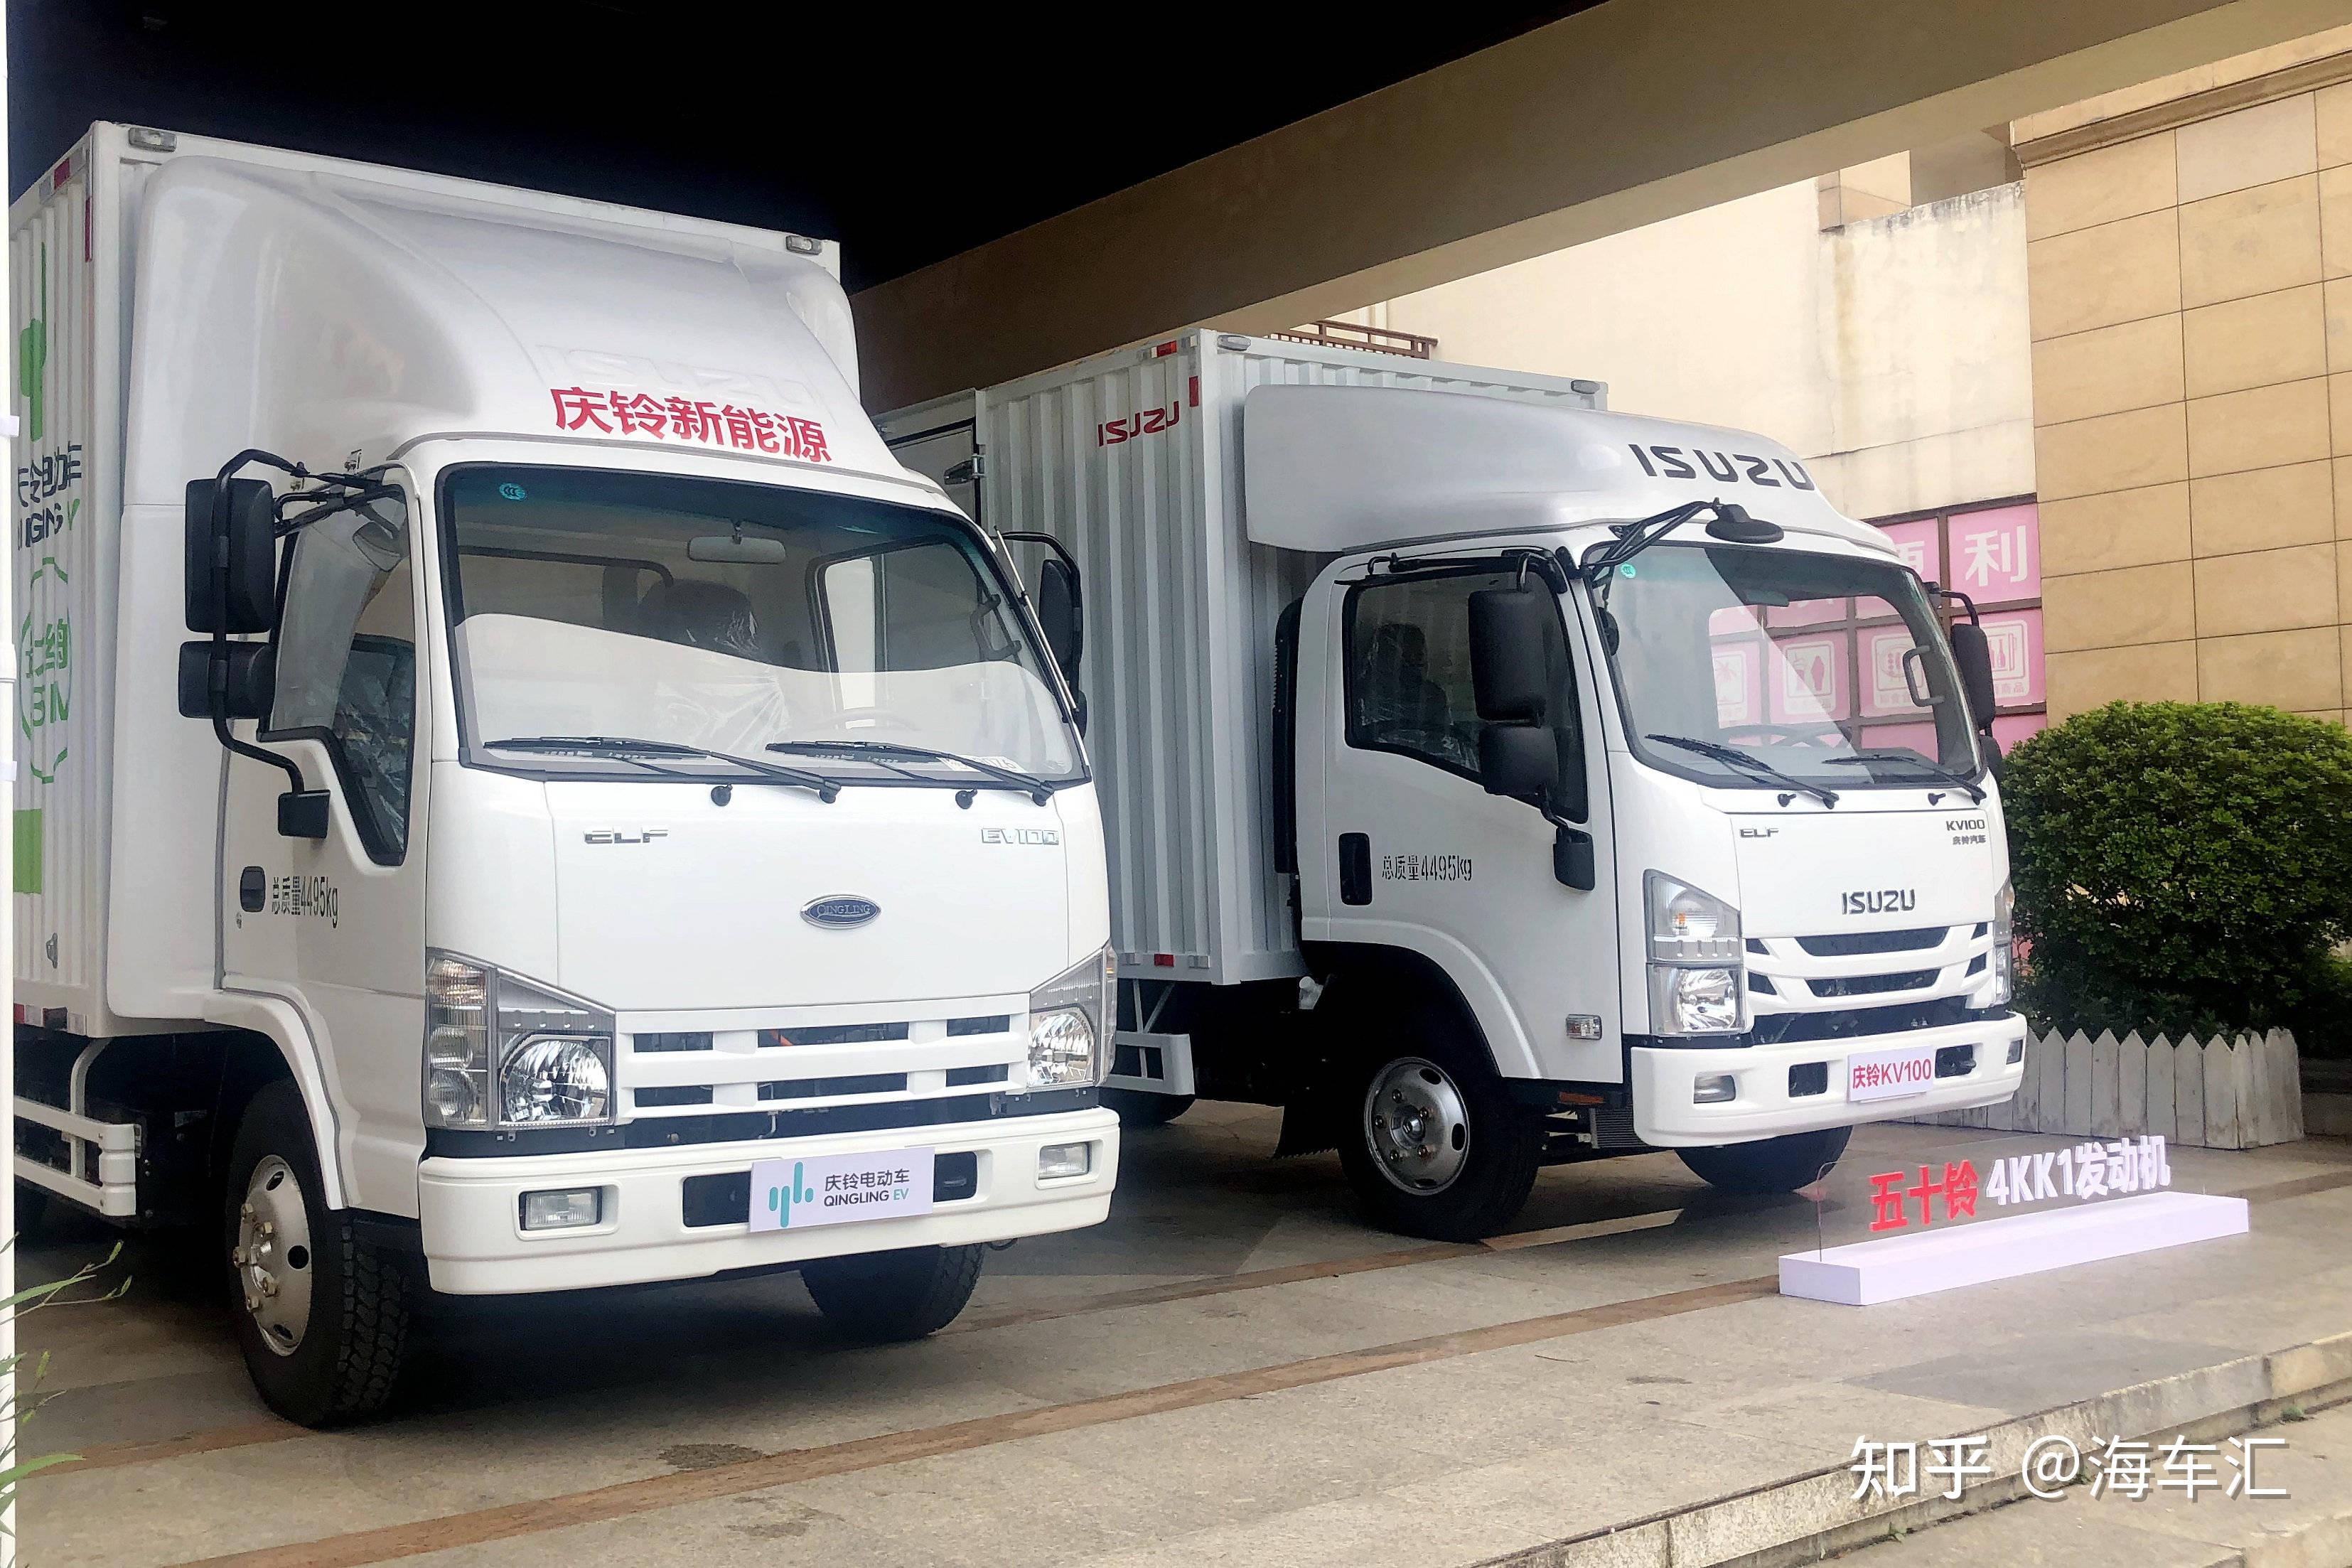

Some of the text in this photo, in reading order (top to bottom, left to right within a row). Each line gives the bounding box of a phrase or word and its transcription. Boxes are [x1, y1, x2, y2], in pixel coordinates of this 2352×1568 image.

[550, 386, 832, 463] 庆铃新能源
[1098, 400, 1180, 446] ISUZU
[1628, 444, 1815, 490] ISUZU
[583, 827, 669, 844] ELF
[981, 827, 1059, 845] EV100
[1739, 827, 1780, 838] ELF
[1945, 819, 1985, 831] KV100
[1382, 855, 1473, 881] 总质量4495kg
[272, 875, 339, 929] 总质量4495kg
[1842, 889, 1915, 914] ISUZU
[1852, 1058, 1931, 1090] 庆铃KV100
[825, 1169, 909, 1191] 庆铃电动车
[1869, 1135, 2171, 1232] 五十铃 4KK1发动机
[824, 1188, 909, 1207] QINGLING EV
